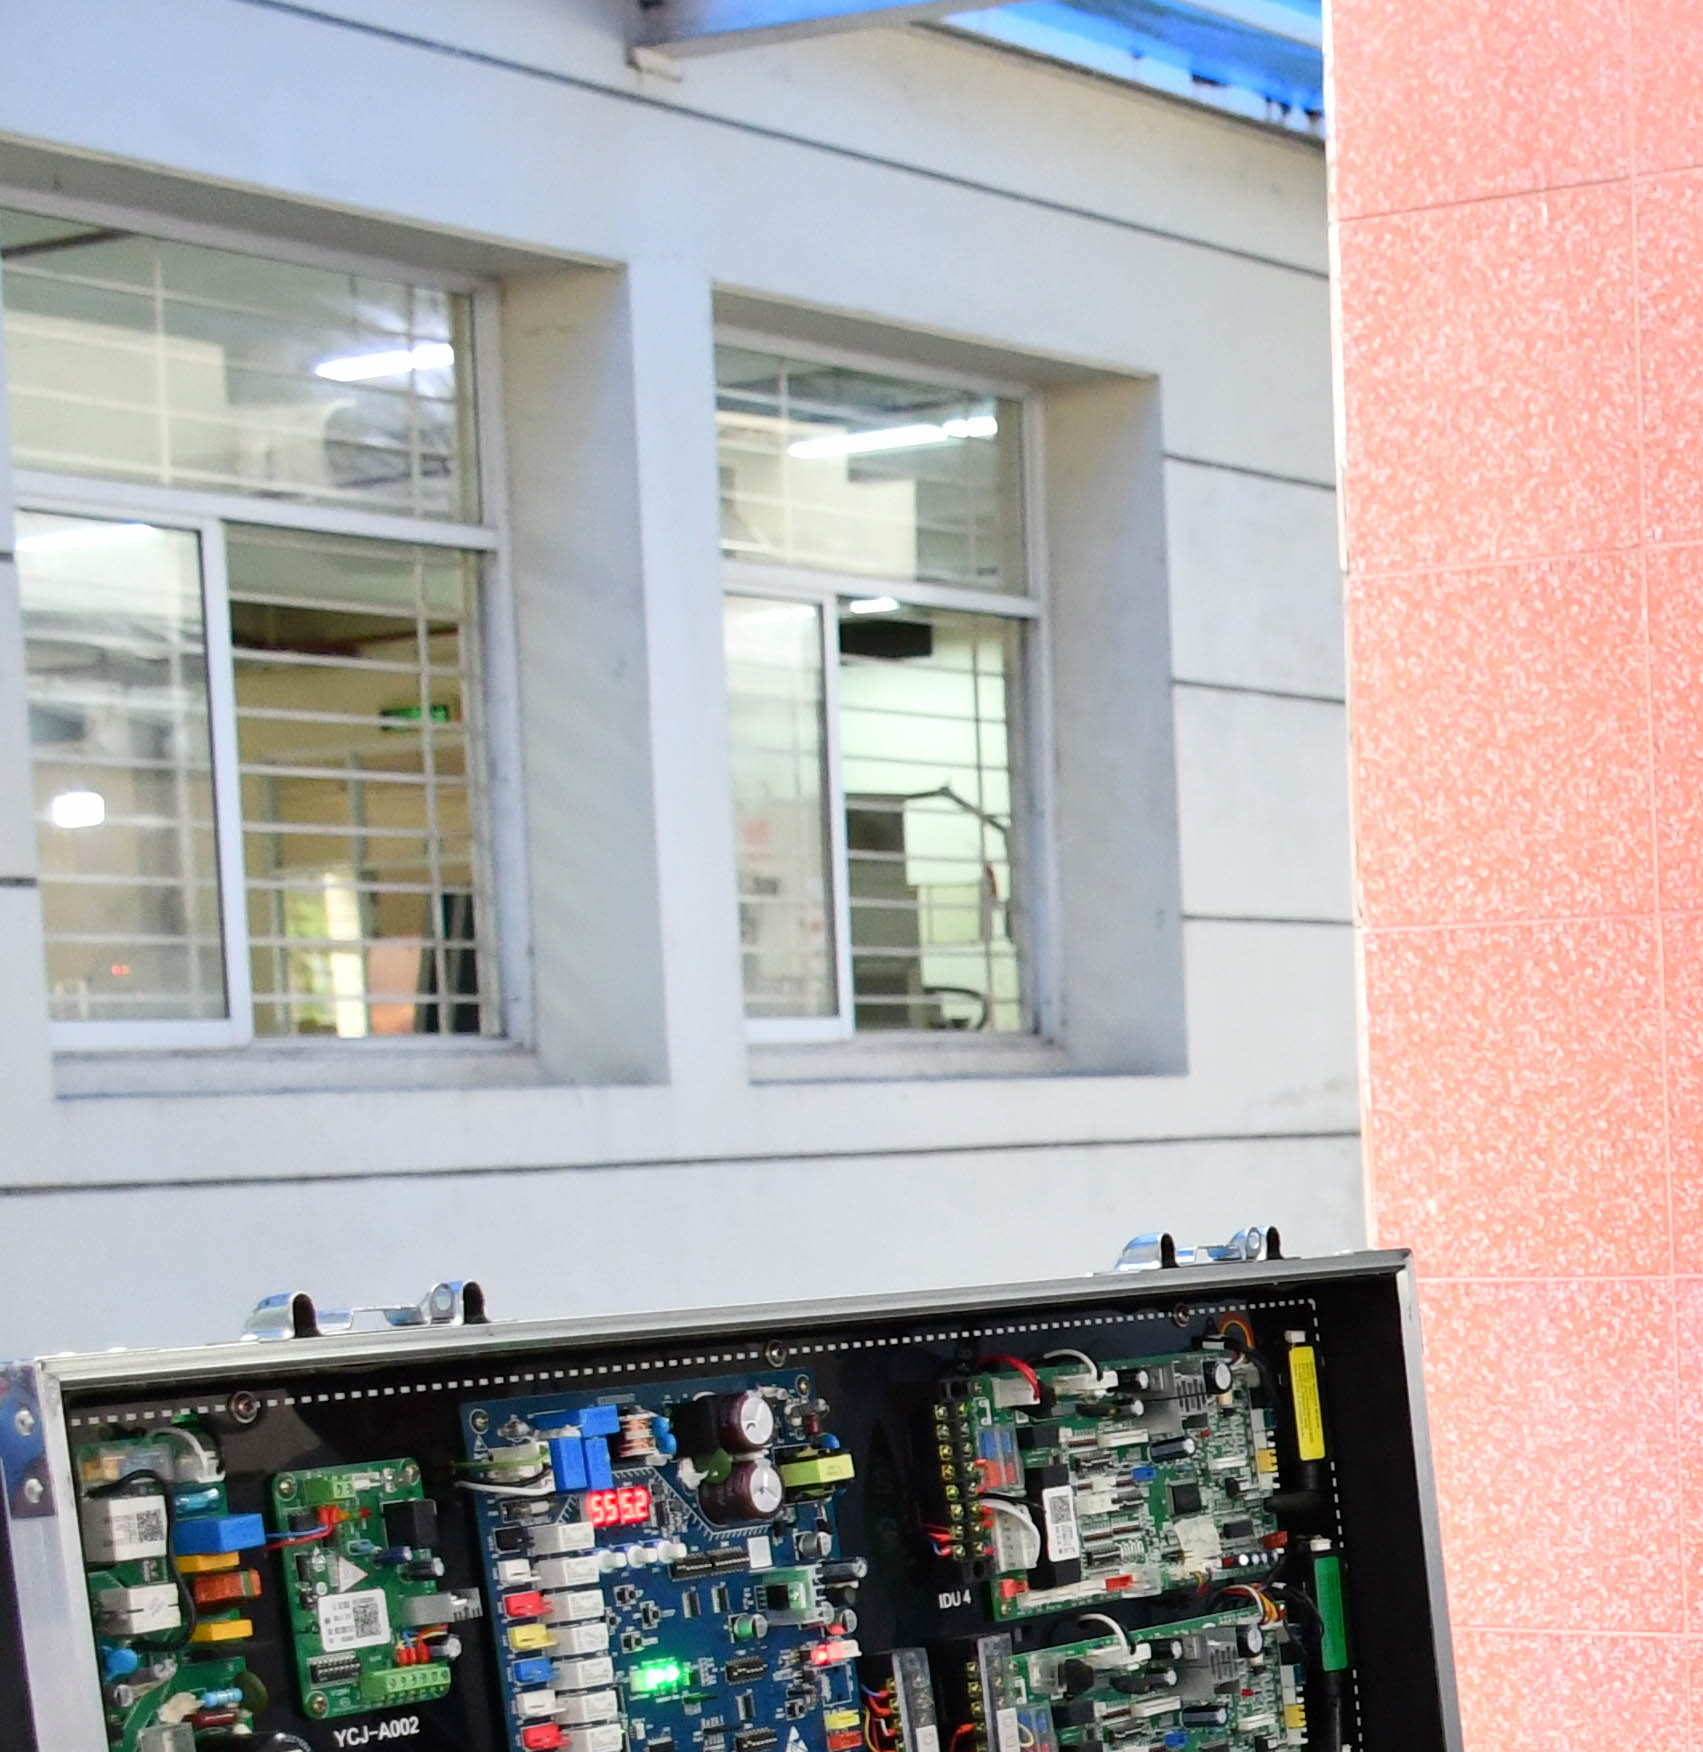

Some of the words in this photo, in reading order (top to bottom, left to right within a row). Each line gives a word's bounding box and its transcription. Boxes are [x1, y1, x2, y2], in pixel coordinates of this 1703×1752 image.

[938, 1590, 961, 1610] IDU
[962, 1588, 971, 1604] 4
[333, 1715, 420, 1749] YCJ-A002
